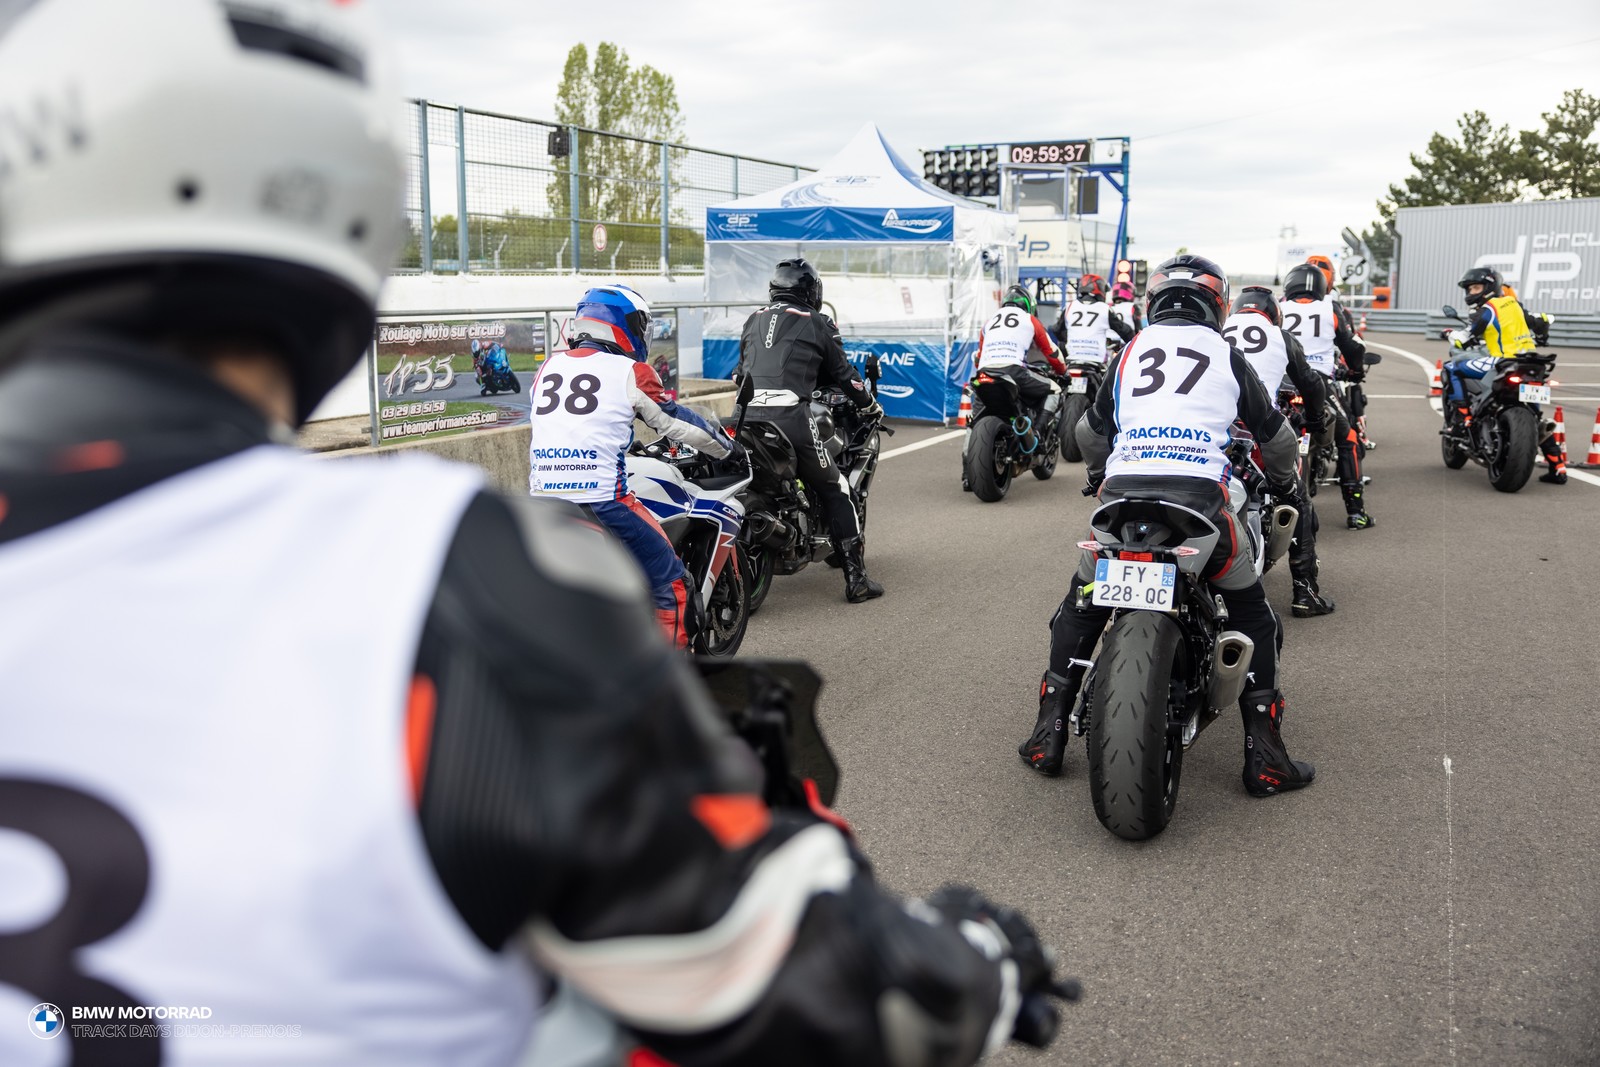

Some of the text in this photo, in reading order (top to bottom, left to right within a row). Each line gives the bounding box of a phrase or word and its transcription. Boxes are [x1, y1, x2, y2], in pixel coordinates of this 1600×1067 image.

[1012, 144, 1086, 163] 09:59:37
[1346, 264, 1364, 276] 60
[989, 313, 1019, 330] 26
[1071, 311, 1099, 327] 27
[1285, 313, 1321, 338] 21
[380, 321, 506, 345] Roulage Moto sur circuits
[1131, 347, 1210, 397] 37
[536, 373, 601, 415] 38
[382, 406, 394, 419] 03
[396, 405, 408, 417] 29
[410, 403, 422, 415] 83
[433, 400, 446, 412] 58
[383, 411, 498, 439] www.teamperformance55.com
[1126, 427, 1211, 443] TRACKDAYS
[1141, 451, 1209, 465] MICHELIN
[543, 481, 598, 489] MICHELIN
[1162, 576, 1173, 585] 25
